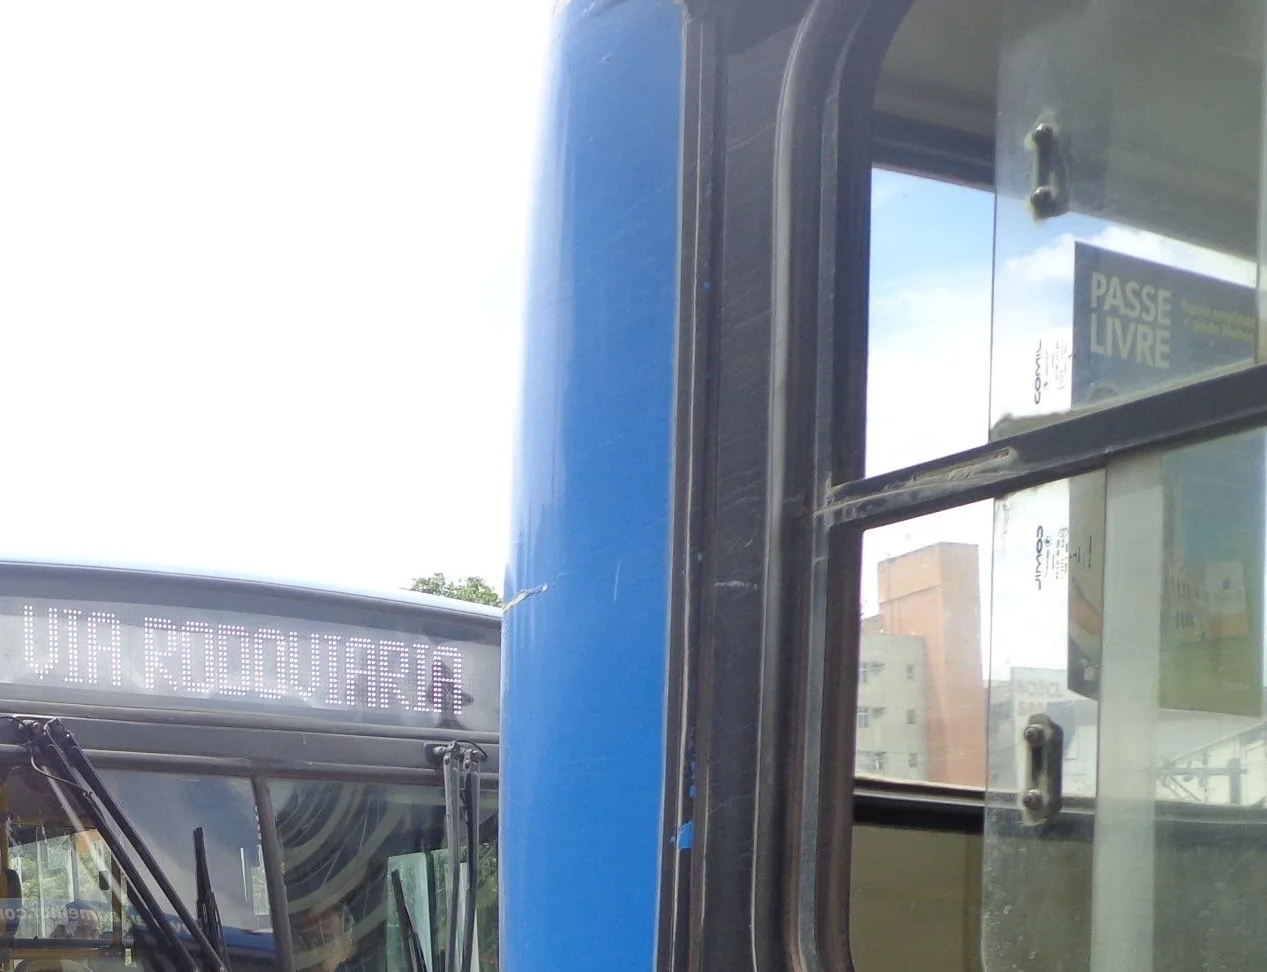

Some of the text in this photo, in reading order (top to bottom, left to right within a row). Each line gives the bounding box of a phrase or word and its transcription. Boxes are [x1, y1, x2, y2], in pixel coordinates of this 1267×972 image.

[1090, 271, 1172, 326] PASSE
[1089, 313, 1171, 370] LIVRE
[23, 604, 122, 687] VIA
